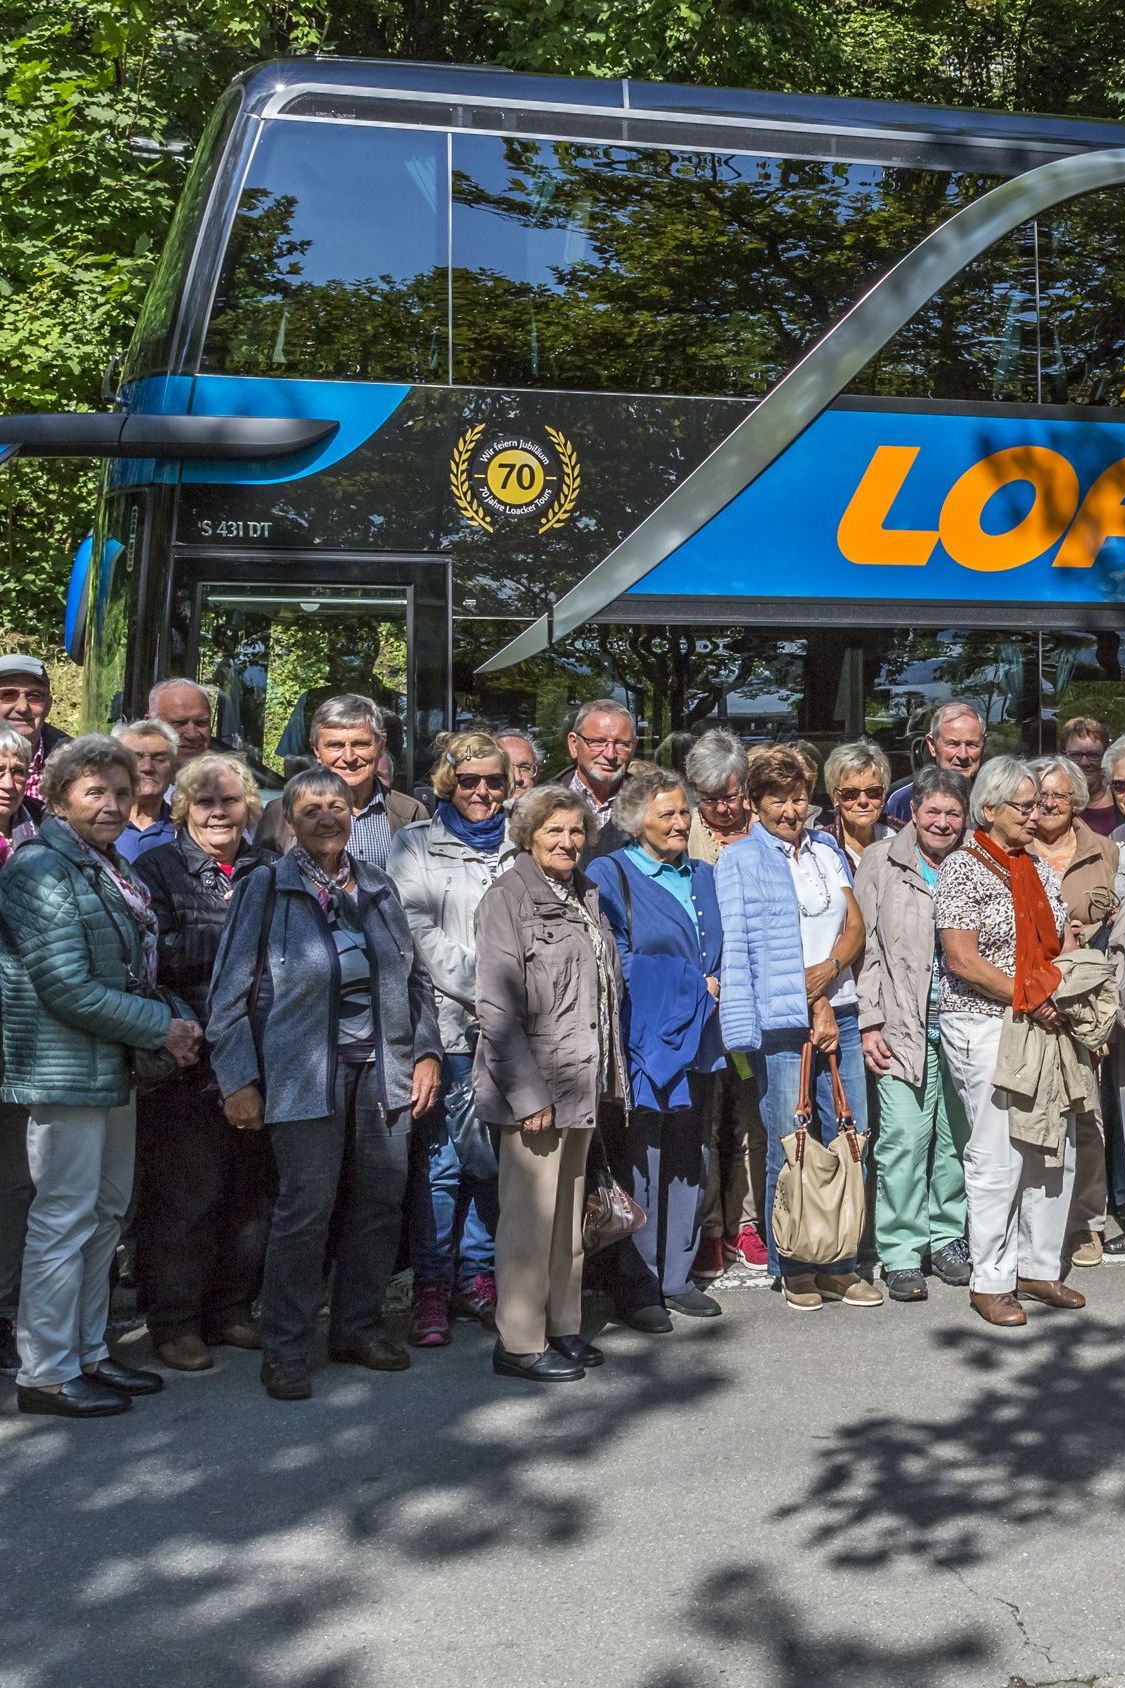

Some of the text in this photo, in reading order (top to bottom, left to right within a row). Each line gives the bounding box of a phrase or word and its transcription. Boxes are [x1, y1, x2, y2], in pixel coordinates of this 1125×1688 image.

[479, 439, 550, 465] Wir feiern Jubiläum
[498, 463, 535, 490] 70
[479, 487, 553, 515] 70 Jahre Loacker Tours
[201, 520, 273, 538] S 431 DT
